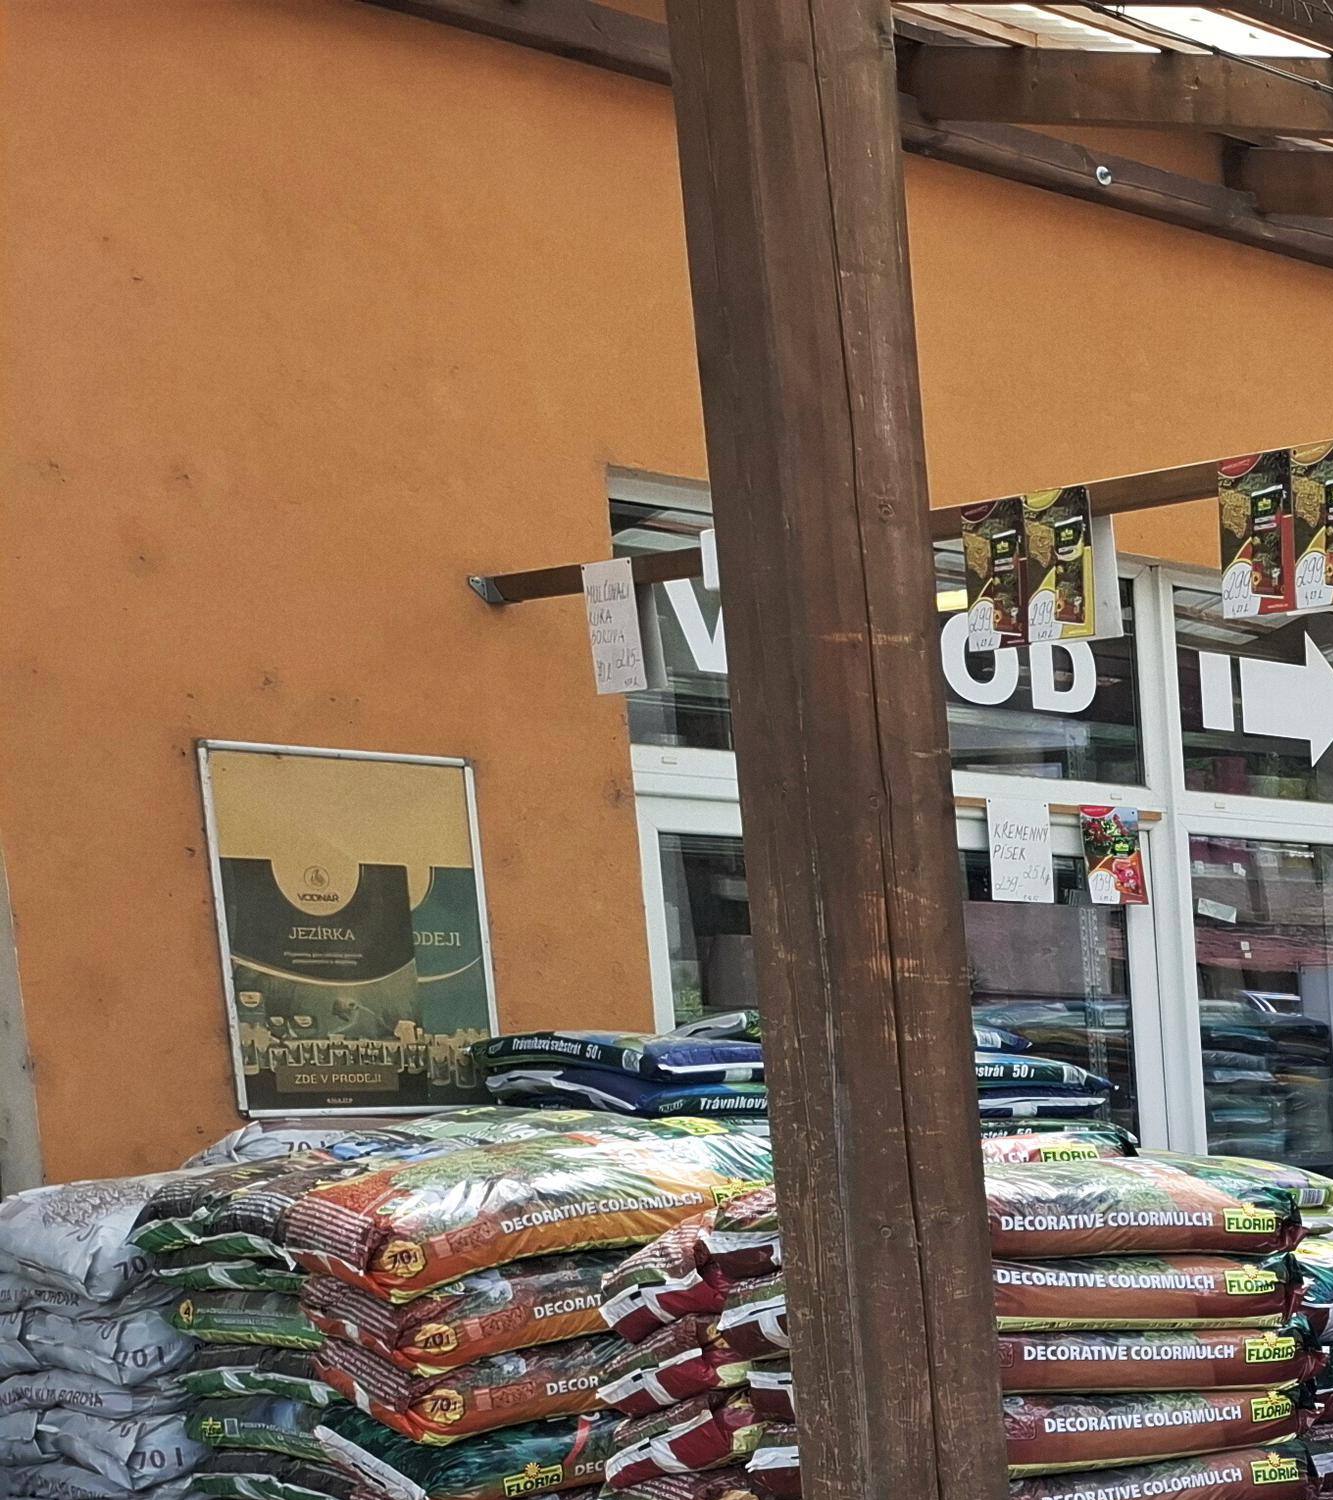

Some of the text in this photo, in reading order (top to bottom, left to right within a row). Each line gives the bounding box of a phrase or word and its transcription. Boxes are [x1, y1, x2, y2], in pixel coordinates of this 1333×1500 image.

[993, 845, 1026, 861] PÍSEK
[289, 926, 356, 941] JEZÍRKA
[586, 1044, 598, 1059] 50
[296, 1072, 381, 1084] ZDE V PRODEJI
[1012, 1064, 1029, 1079] 50
[502, 1191, 704, 1235] DECORATIVE COLORMULCH
[1001, 1212, 1214, 1232] DECORATIVE COLORMULCH
[1227, 1217, 1275, 1231] FLORIA
[1023, 1345, 1235, 1361] DECORATIVE COLORMULCH
[1247, 1347, 1294, 1361] FLORIA
[506, 1473, 562, 1496] FLORIA
